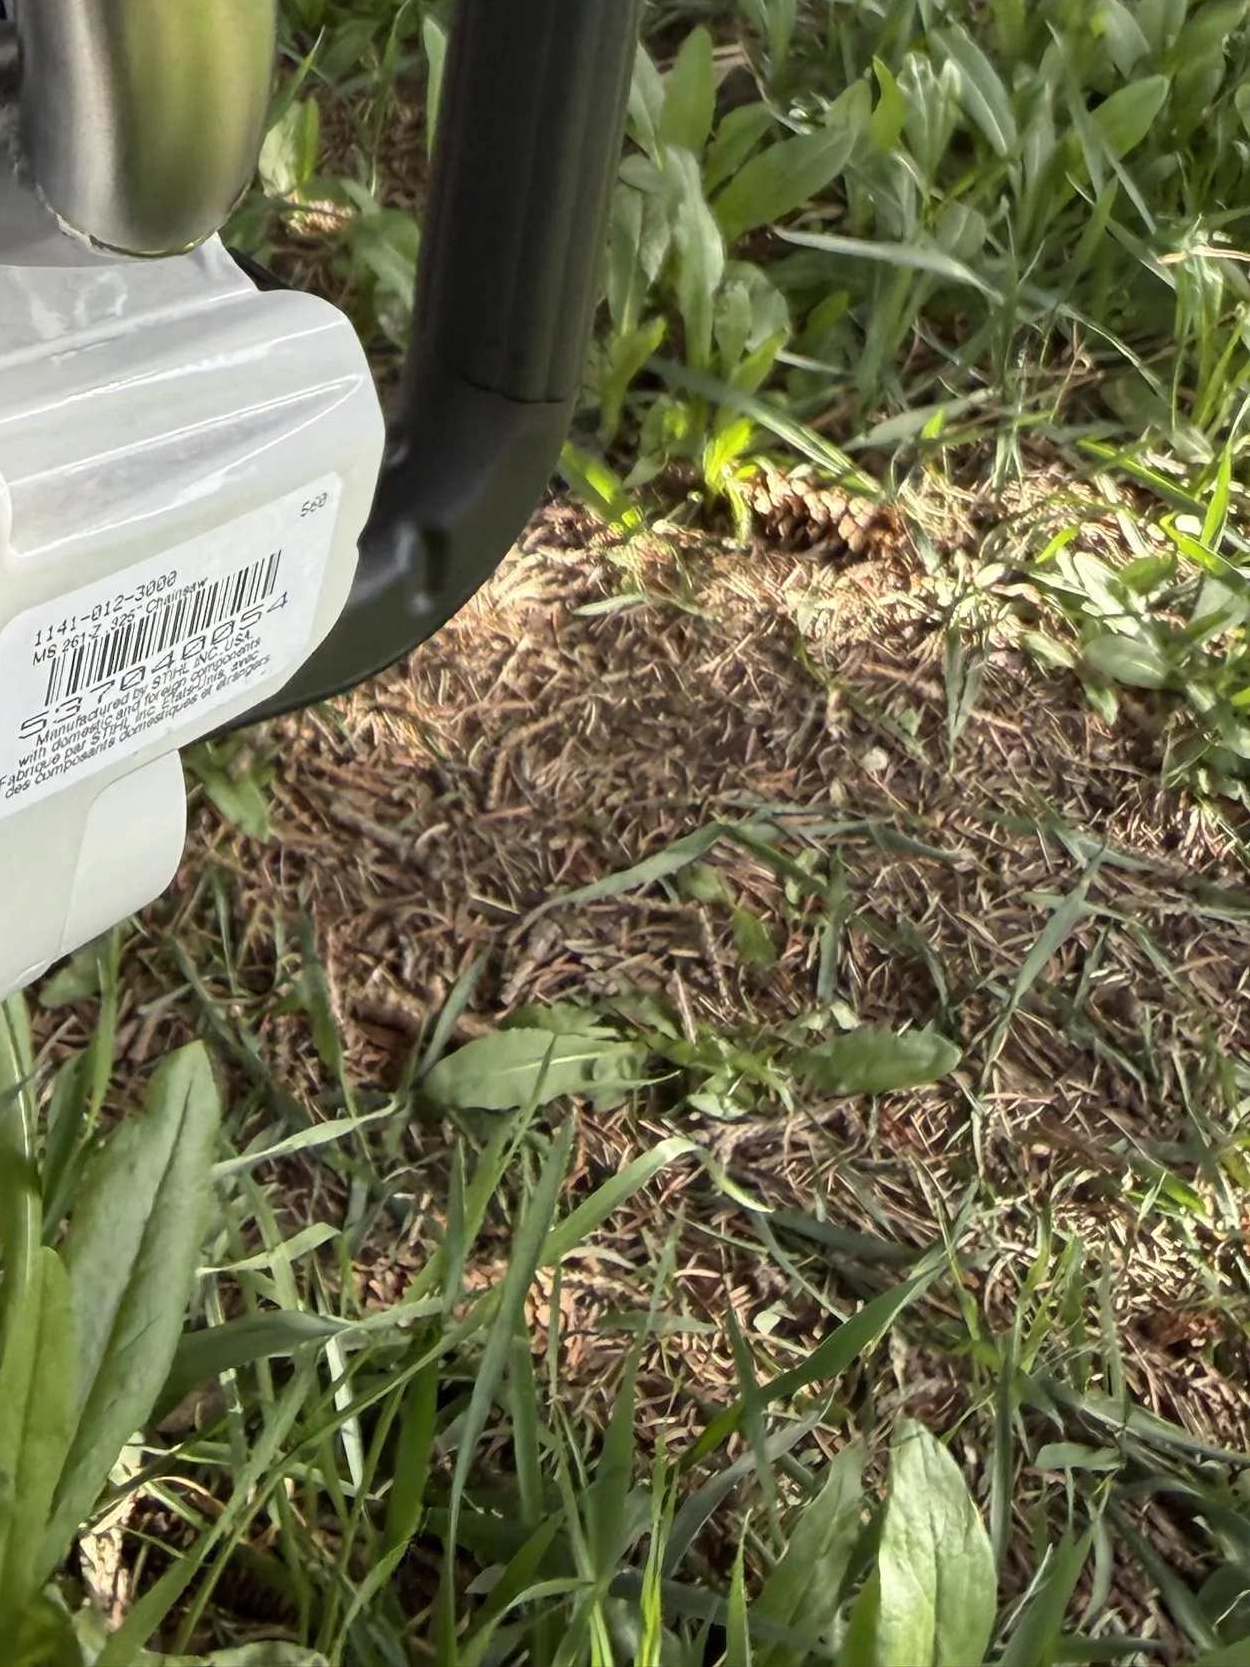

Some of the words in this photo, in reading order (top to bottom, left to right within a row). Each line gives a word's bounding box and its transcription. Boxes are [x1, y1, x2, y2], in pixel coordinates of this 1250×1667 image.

[32, 644, 57, 666] MS
[146, 577, 208, 614] Chainsaw
[34, 570, 178, 647] 1141-012-3000
[18, 746, 47, 767] with
[51, 714, 113, 752] domestic
[115, 698, 141, 721] and
[144, 677, 187, 707] foreign
[36, 691, 130, 746] Manufactured
[133, 684, 148, 701] by
[151, 663, 190, 690] STIHL
[4, 779, 31, 799] des
[64, 739, 87, 761] par
